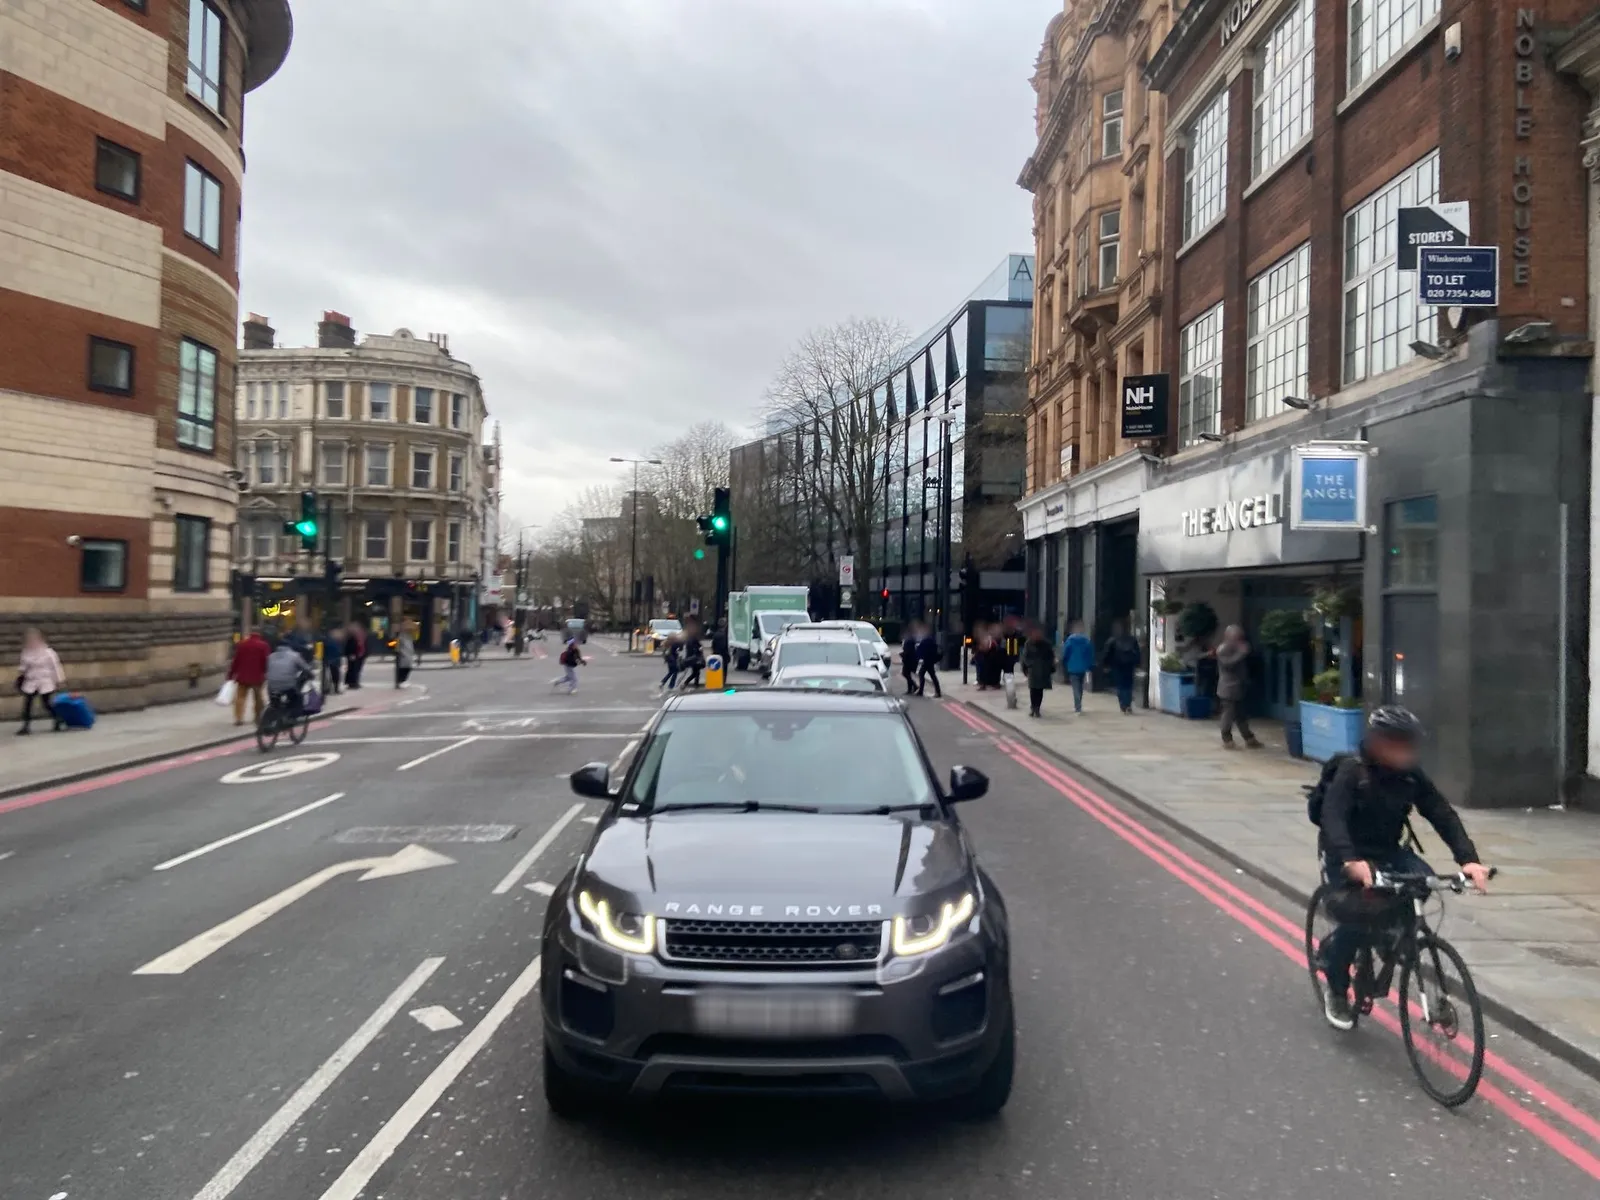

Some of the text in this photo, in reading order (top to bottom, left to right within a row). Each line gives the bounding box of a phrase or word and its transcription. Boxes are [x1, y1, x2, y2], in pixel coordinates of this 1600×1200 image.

[1220, 0, 1260, 47] NOB
[1513, 7, 1535, 285] NOBLE HOUSE
[1408, 230, 1454, 245] STOREYS
[1427, 254, 1473, 263] Winkworth
[1013, 256, 1032, 280] A
[1427, 275, 1466, 285] TO LET
[1427, 289, 1444, 298] 020
[1446, 289, 1468, 298] 7354
[1126, 386, 1154, 405] NH
[1315, 474, 1345, 486] THE
[1303, 487, 1356, 499] ANGEL
[1181, 492, 1277, 537] THE ANGEL
[665, 902, 882, 916] RANGE ROVER
